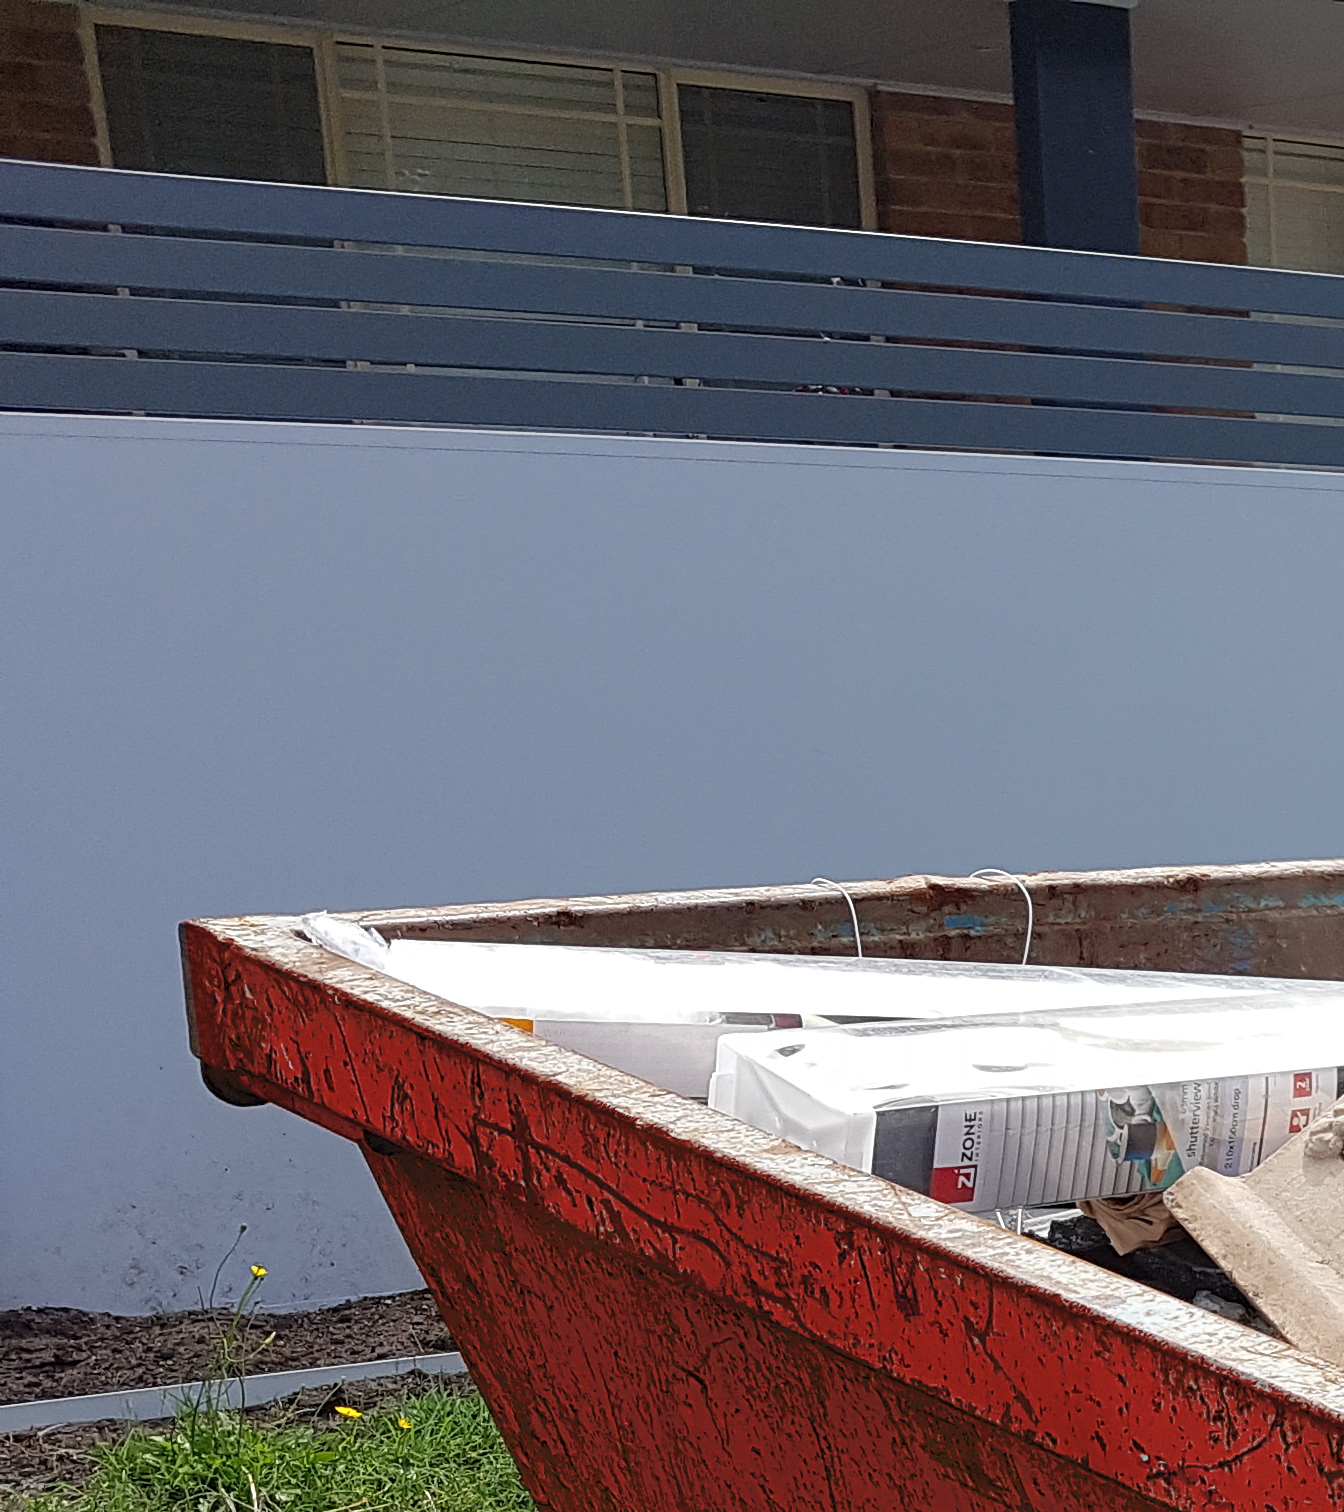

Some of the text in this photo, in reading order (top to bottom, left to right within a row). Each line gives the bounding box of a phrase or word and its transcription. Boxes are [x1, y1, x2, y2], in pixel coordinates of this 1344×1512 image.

[961, 1111, 977, 1163] ZONE
[975, 1110, 983, 1161] INTERIORS
[1186, 1082, 1202, 1158] shutterview
